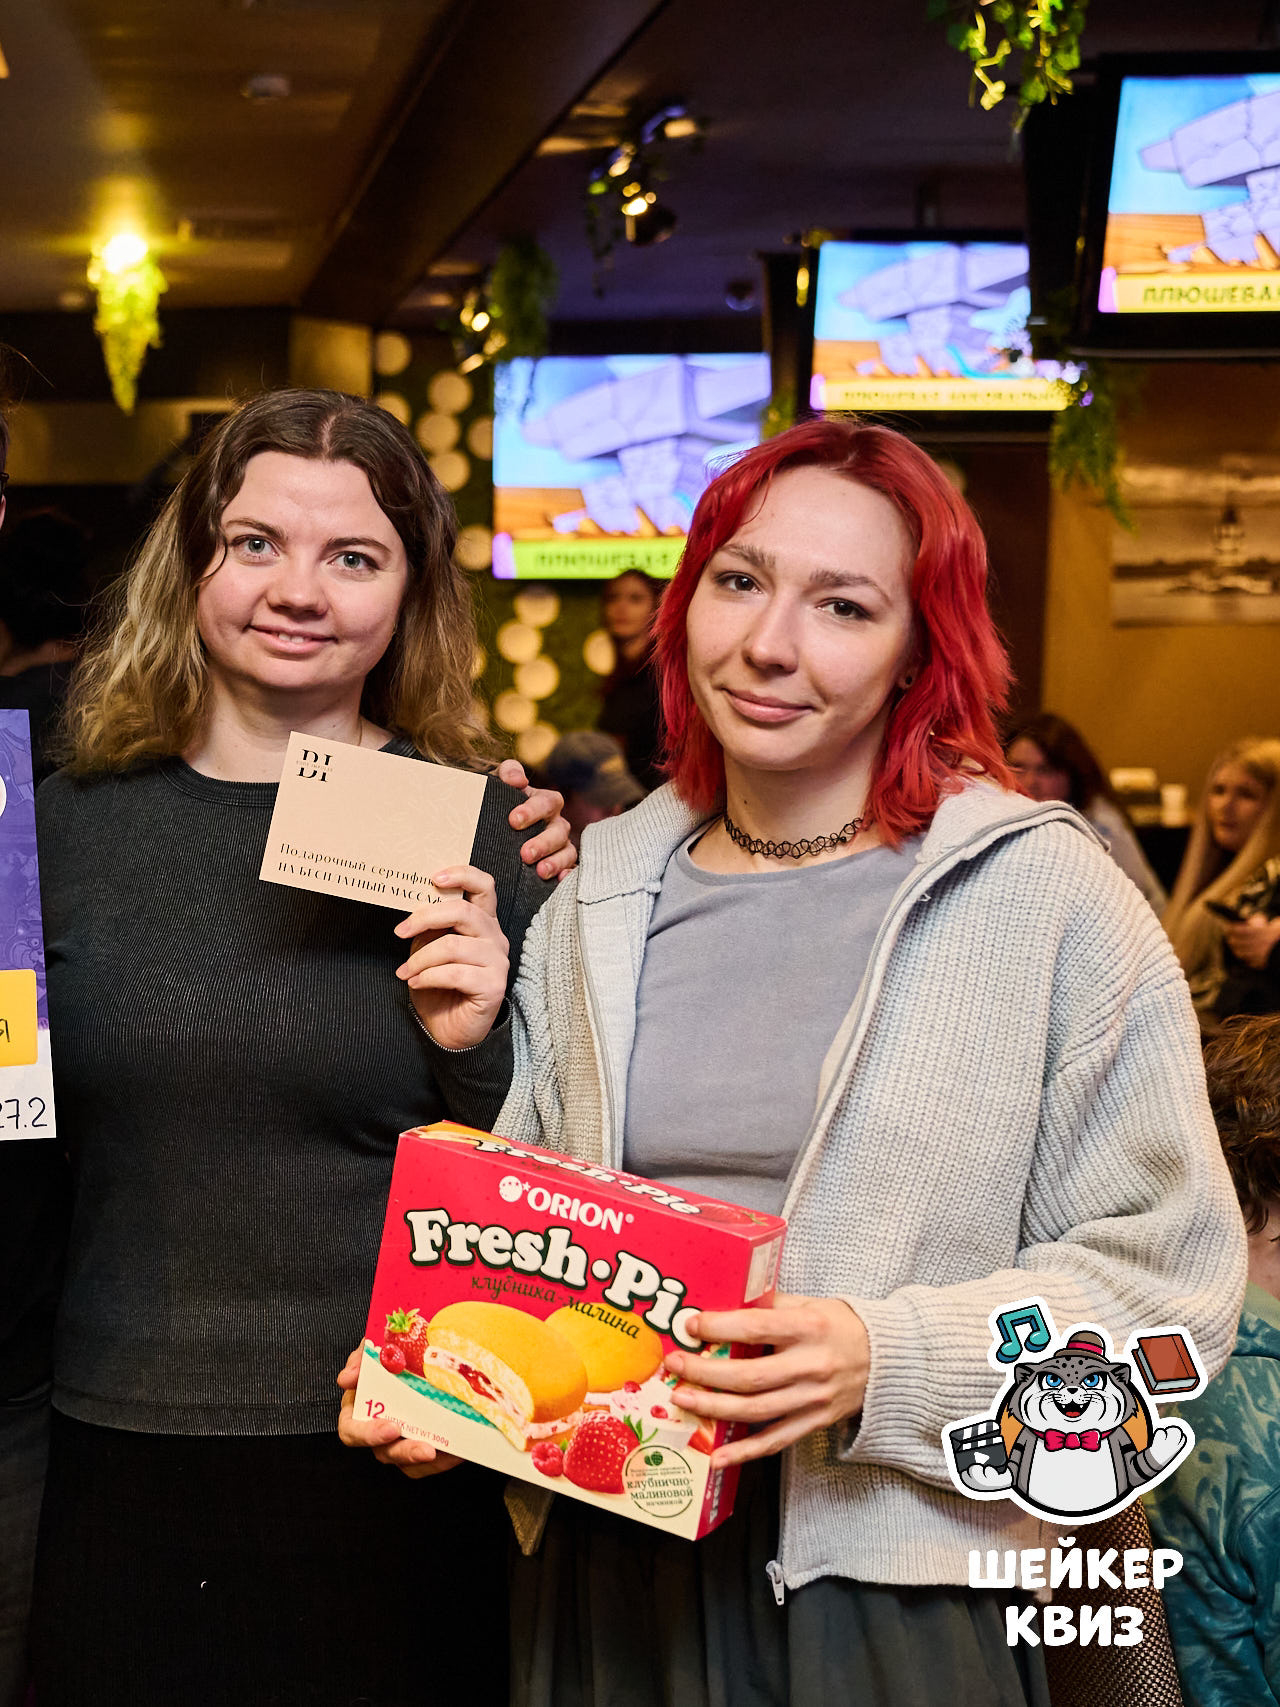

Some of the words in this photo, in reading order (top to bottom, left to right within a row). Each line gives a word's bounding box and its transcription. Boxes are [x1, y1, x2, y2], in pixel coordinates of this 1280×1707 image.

[1143, 285, 1280, 304] ПЛЮШЕВА
[281, 843, 366, 871] Подарочный
[372, 866, 435, 887] сертифик
[527, 1187, 624, 1235] ORION
[365, 1399, 385, 1419] 12
[627, 1477, 693, 1491] клубнично-
[630, 1486, 693, 1500] малиновой
